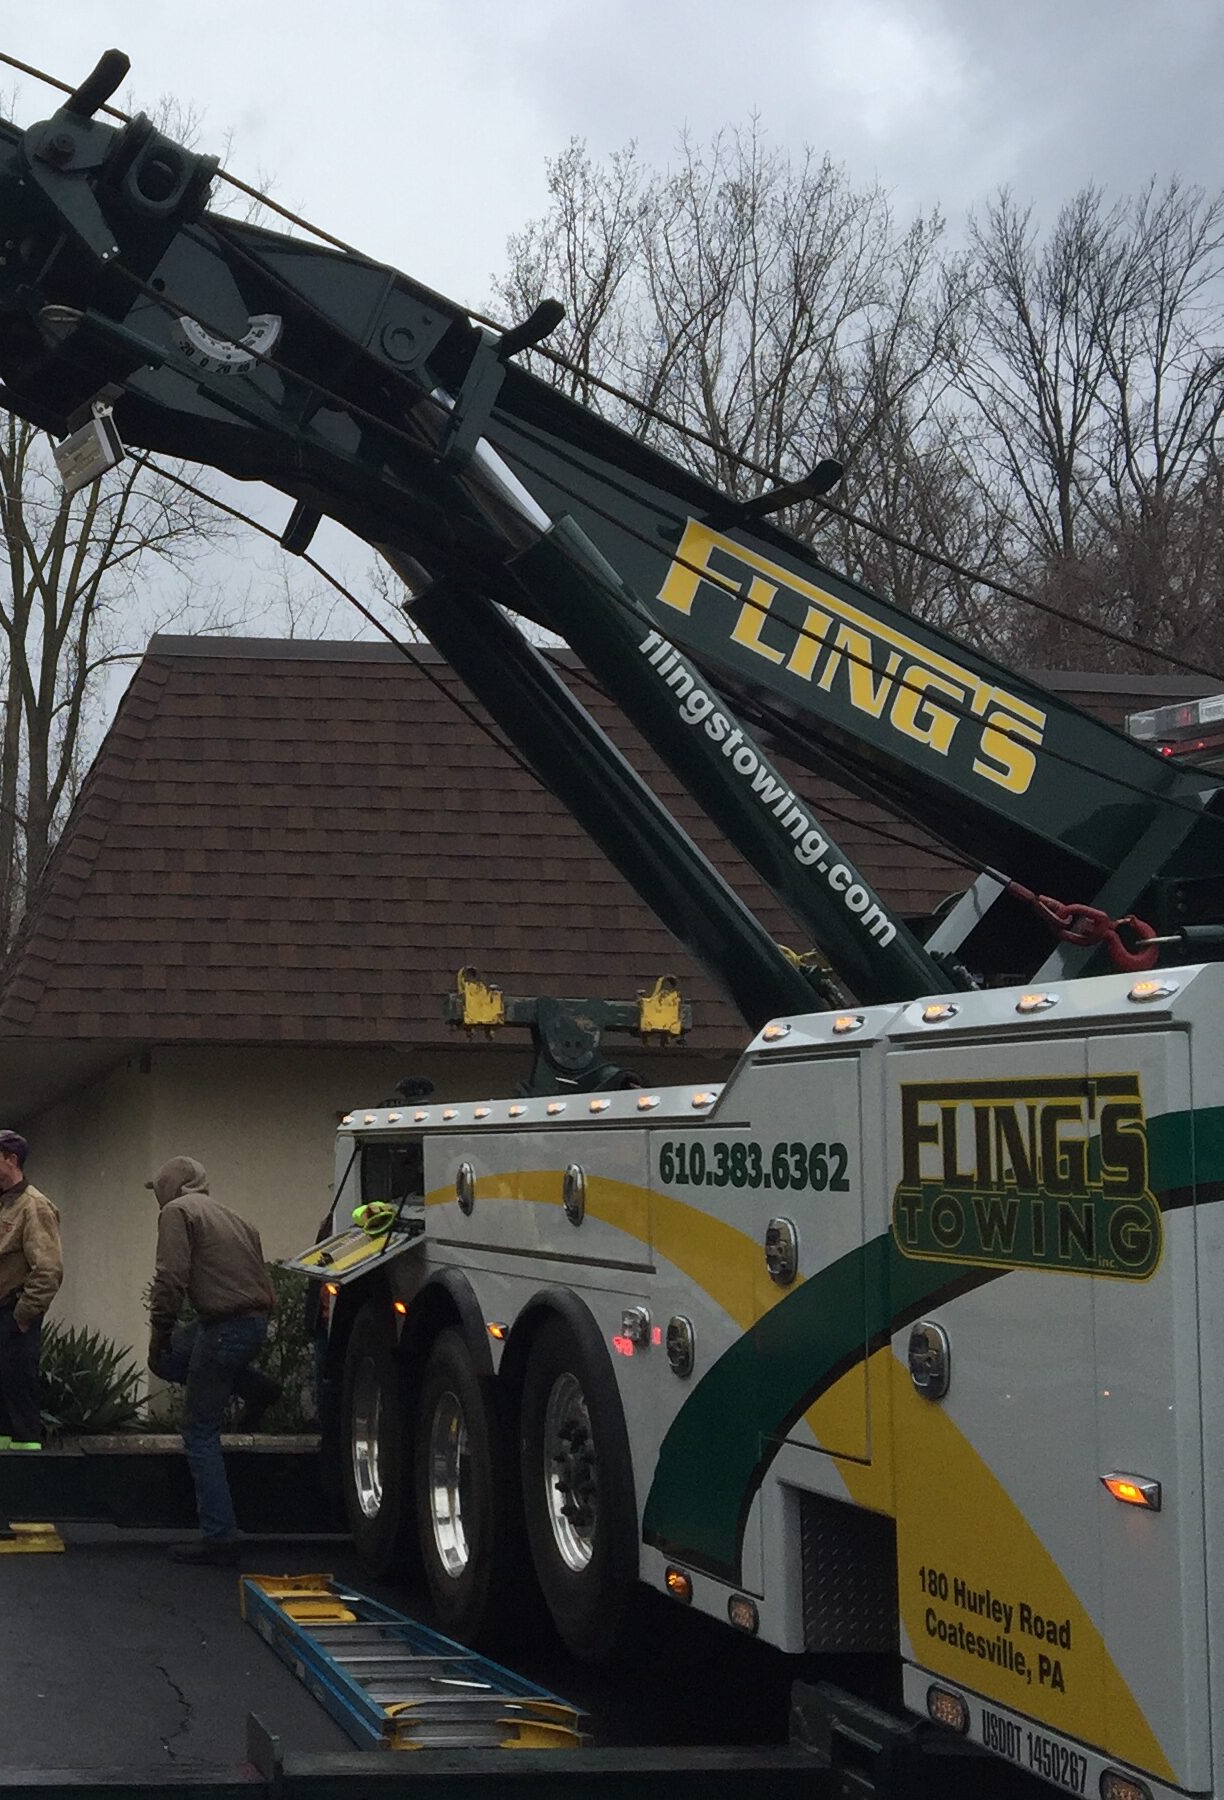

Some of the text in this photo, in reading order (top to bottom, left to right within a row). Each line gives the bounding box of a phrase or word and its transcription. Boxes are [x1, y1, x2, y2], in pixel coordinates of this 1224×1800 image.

[656, 516, 1047, 795] FLING'S
[637, 629, 898, 950] flingstowing.com
[659, 1141, 850, 1193] 610.383.6362
[900, 1074, 1146, 1201] FLING'S
[899, 1193, 1154, 1267] TOWING
[919, 1566, 1072, 1650] 180 Hurley Road
[926, 1608, 1066, 1694] Coatesville, PA
[982, 1709, 1023, 1761] USDOT
